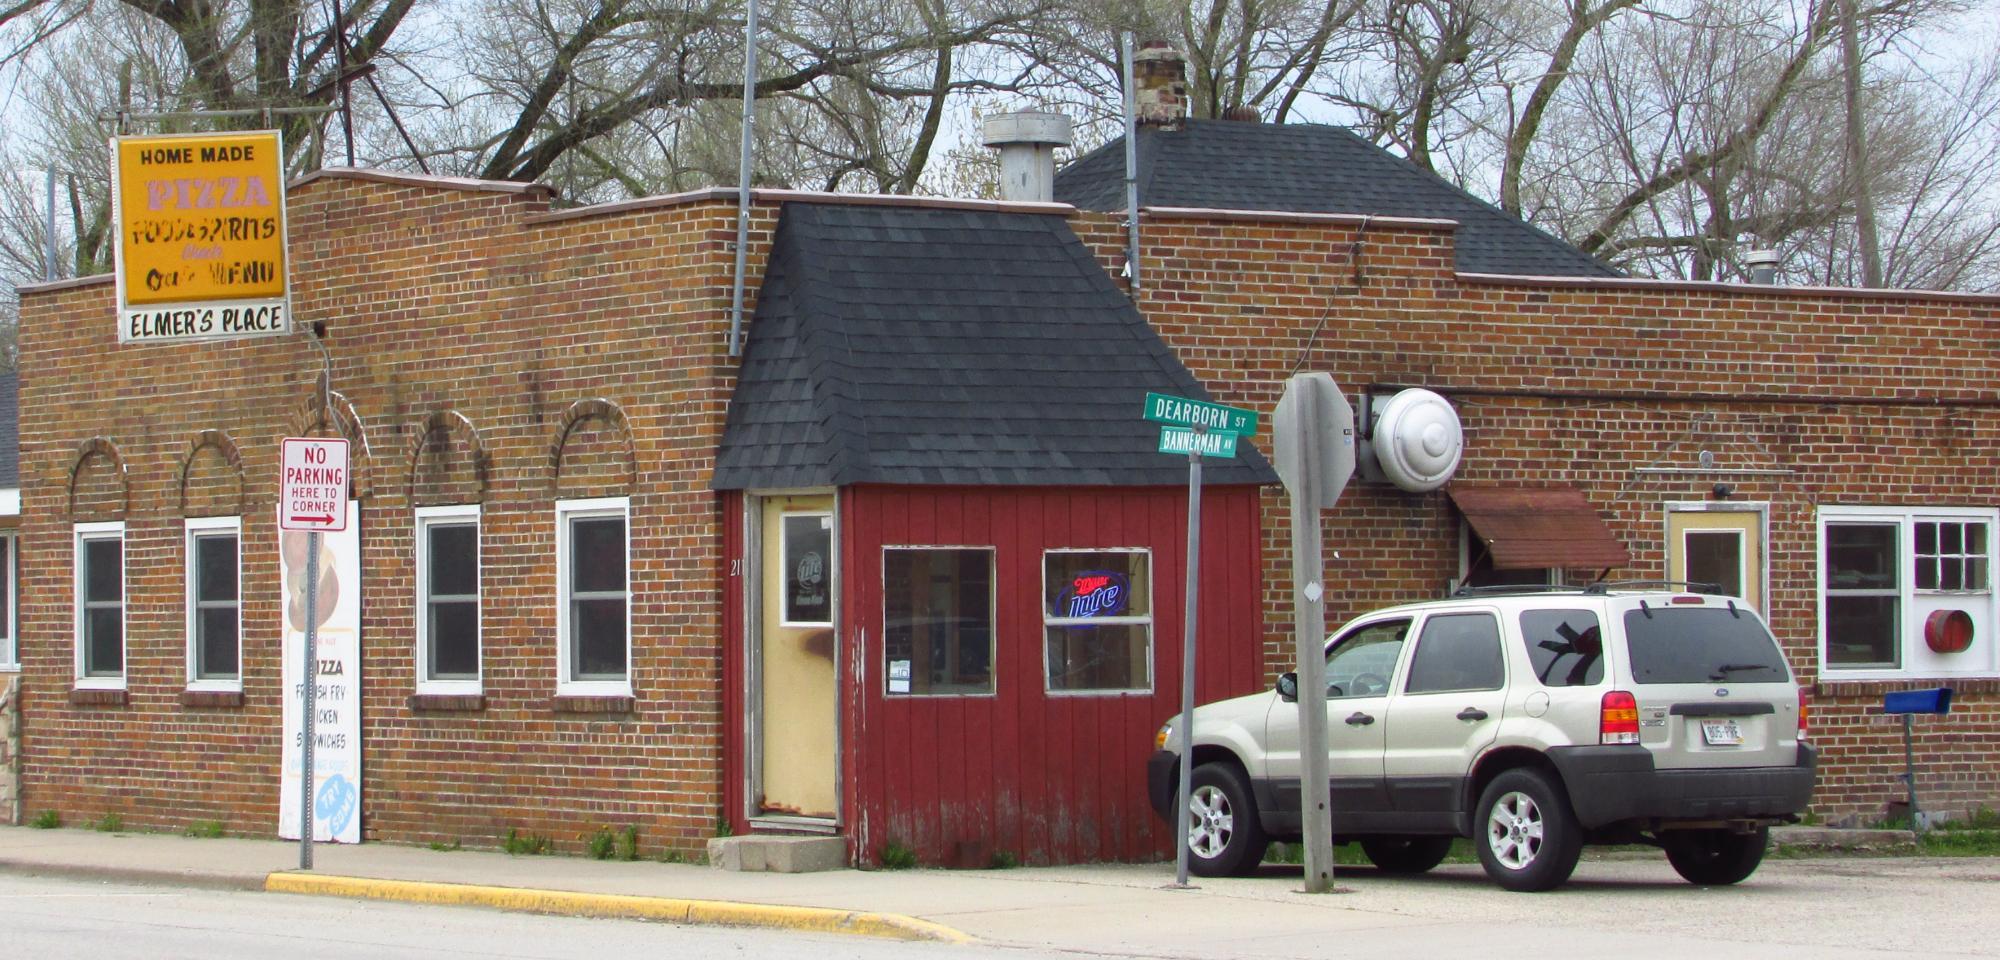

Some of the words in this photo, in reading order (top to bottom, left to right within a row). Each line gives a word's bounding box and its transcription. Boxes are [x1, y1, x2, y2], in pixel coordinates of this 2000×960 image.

[141, 148, 193, 165] HOME
[201, 146, 255, 162] MADE
[145, 175, 272, 211] PIZZA
[131, 307, 213, 338] ELMER'S
[222, 305, 282, 333] PLACE
[1155, 398, 1229, 429] DEARBORN
[1235, 416, 1246, 428] ST
[1163, 431, 1222, 453] BANNERMAN
[1224, 440, 1233, 449] AV
[305, 447, 326, 464] NO
[287, 467, 342, 485] PARKING
[292, 488, 319, 499] HERE
[325, 488, 337, 499] TO
[292, 501, 335, 513] CORNER
[316, 660, 344, 675] IZZA
[330, 684, 346, 700] FRY
[316, 708, 338, 724] ICKEN
